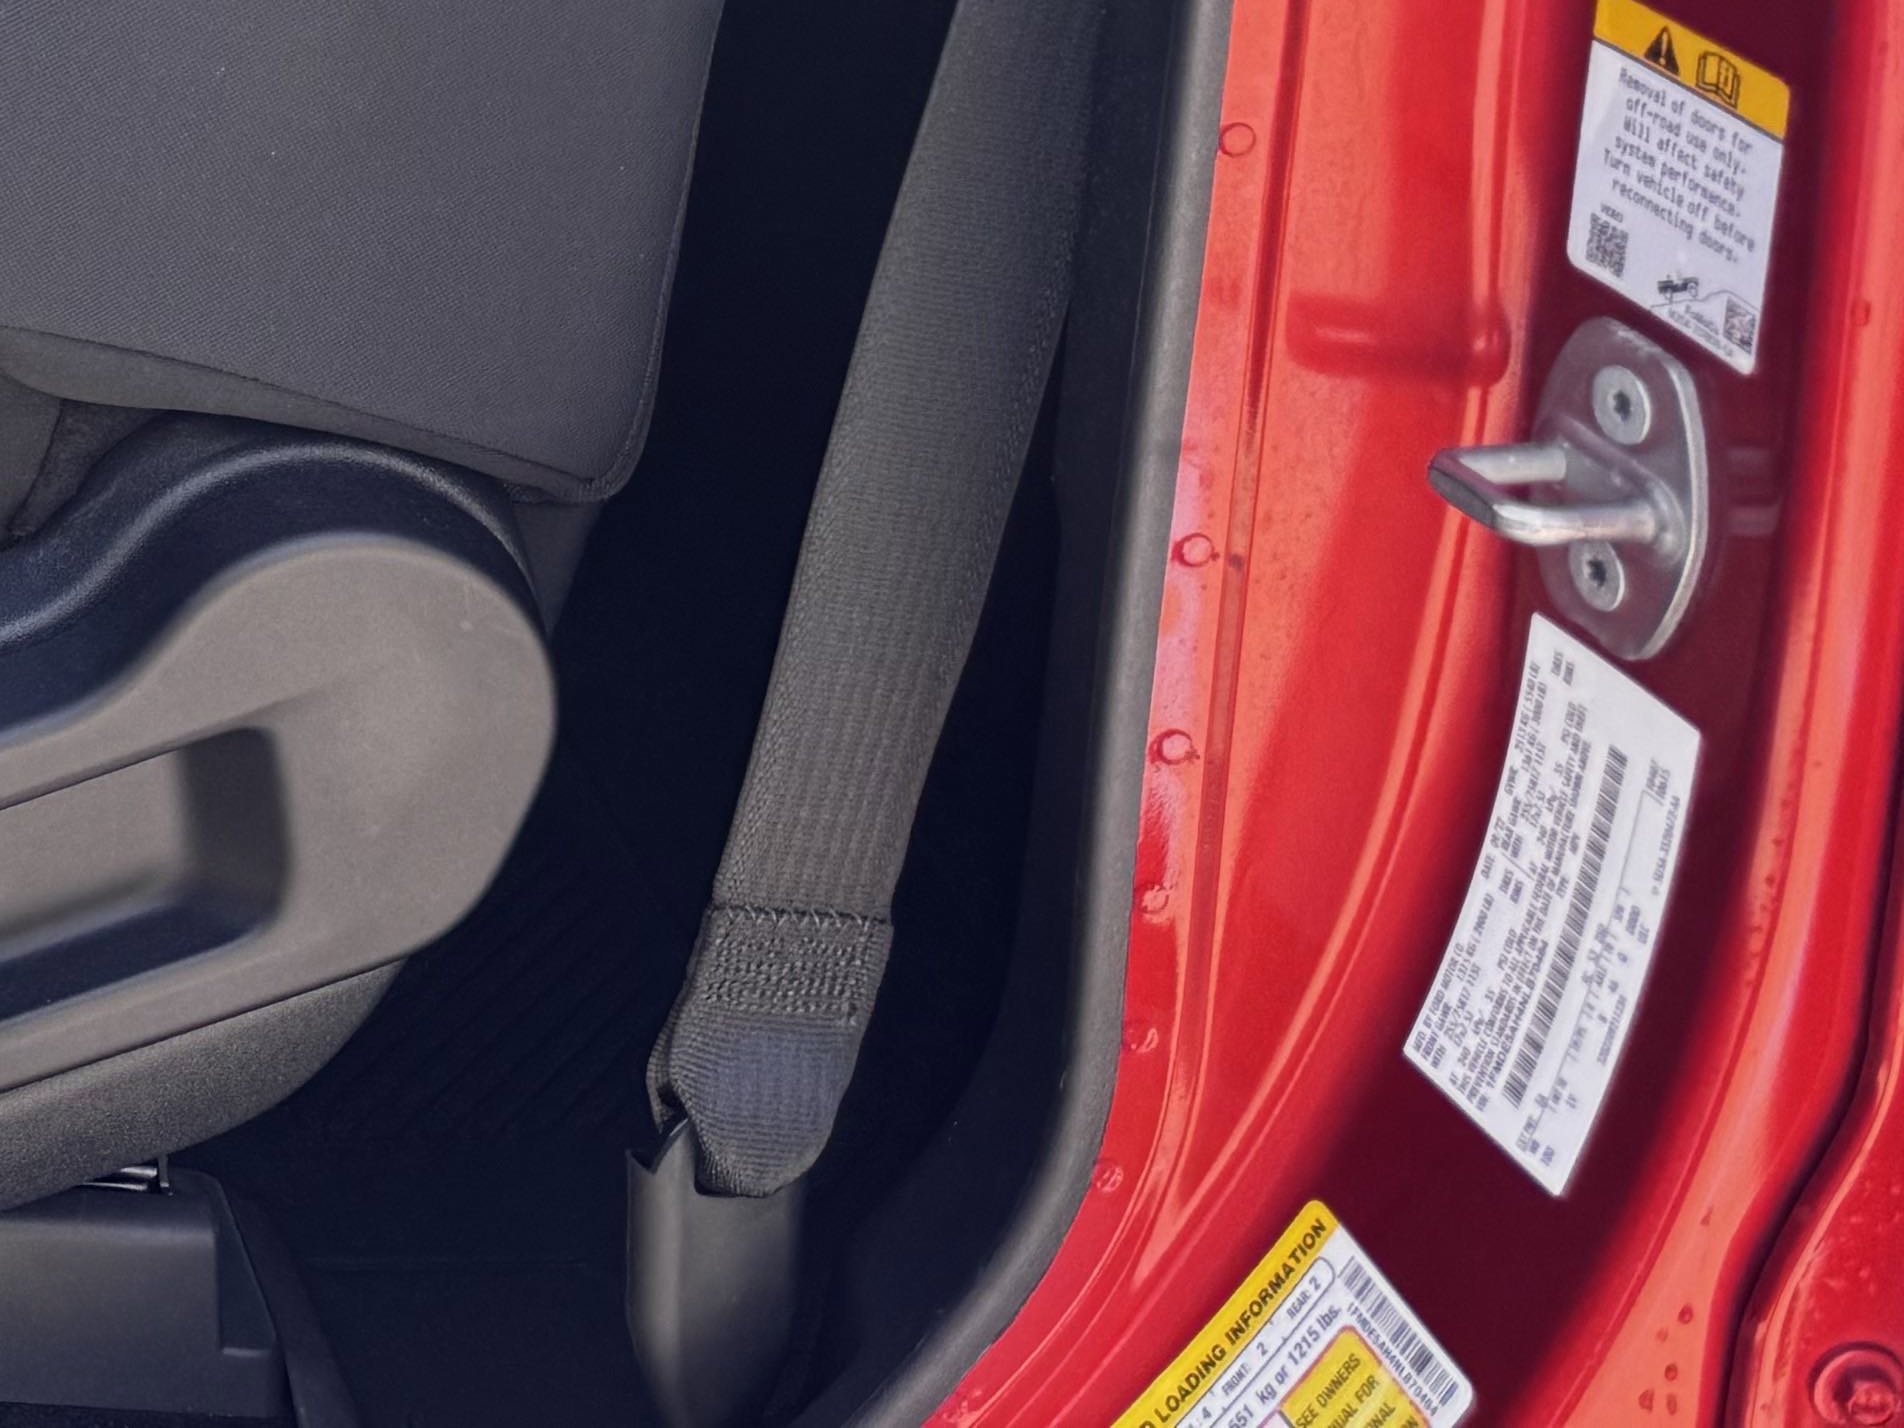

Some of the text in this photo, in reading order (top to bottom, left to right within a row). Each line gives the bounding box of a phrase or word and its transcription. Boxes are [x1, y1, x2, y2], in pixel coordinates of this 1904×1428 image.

[1619, 66, 1753, 154] Removal of doors for
[1626, 97, 1747, 177] off-road use only.
[1615, 135, 1741, 218] system performance.
[1623, 115, 1745, 202] Will affect safety
[1604, 148, 1755, 253] Turn vehicle off before
[1612, 179, 1693, 240] reconnecting
[1154, 1218, 1326, 1423] LOADING INFORMATION
[1202, 1406, 1212, 1420] 4
[1256, 1341, 1268, 1356] 2
[1309, 1275, 1321, 1291] 2
[1256, 1383, 1277, 1404] kg
[1274, 1365, 1289, 1385] or
[1287, 1326, 1321, 1366] 1215
[1295, 1353, 1361, 1428] SEE OWNERS
[1355, 1375, 1381, 1404] FOR
